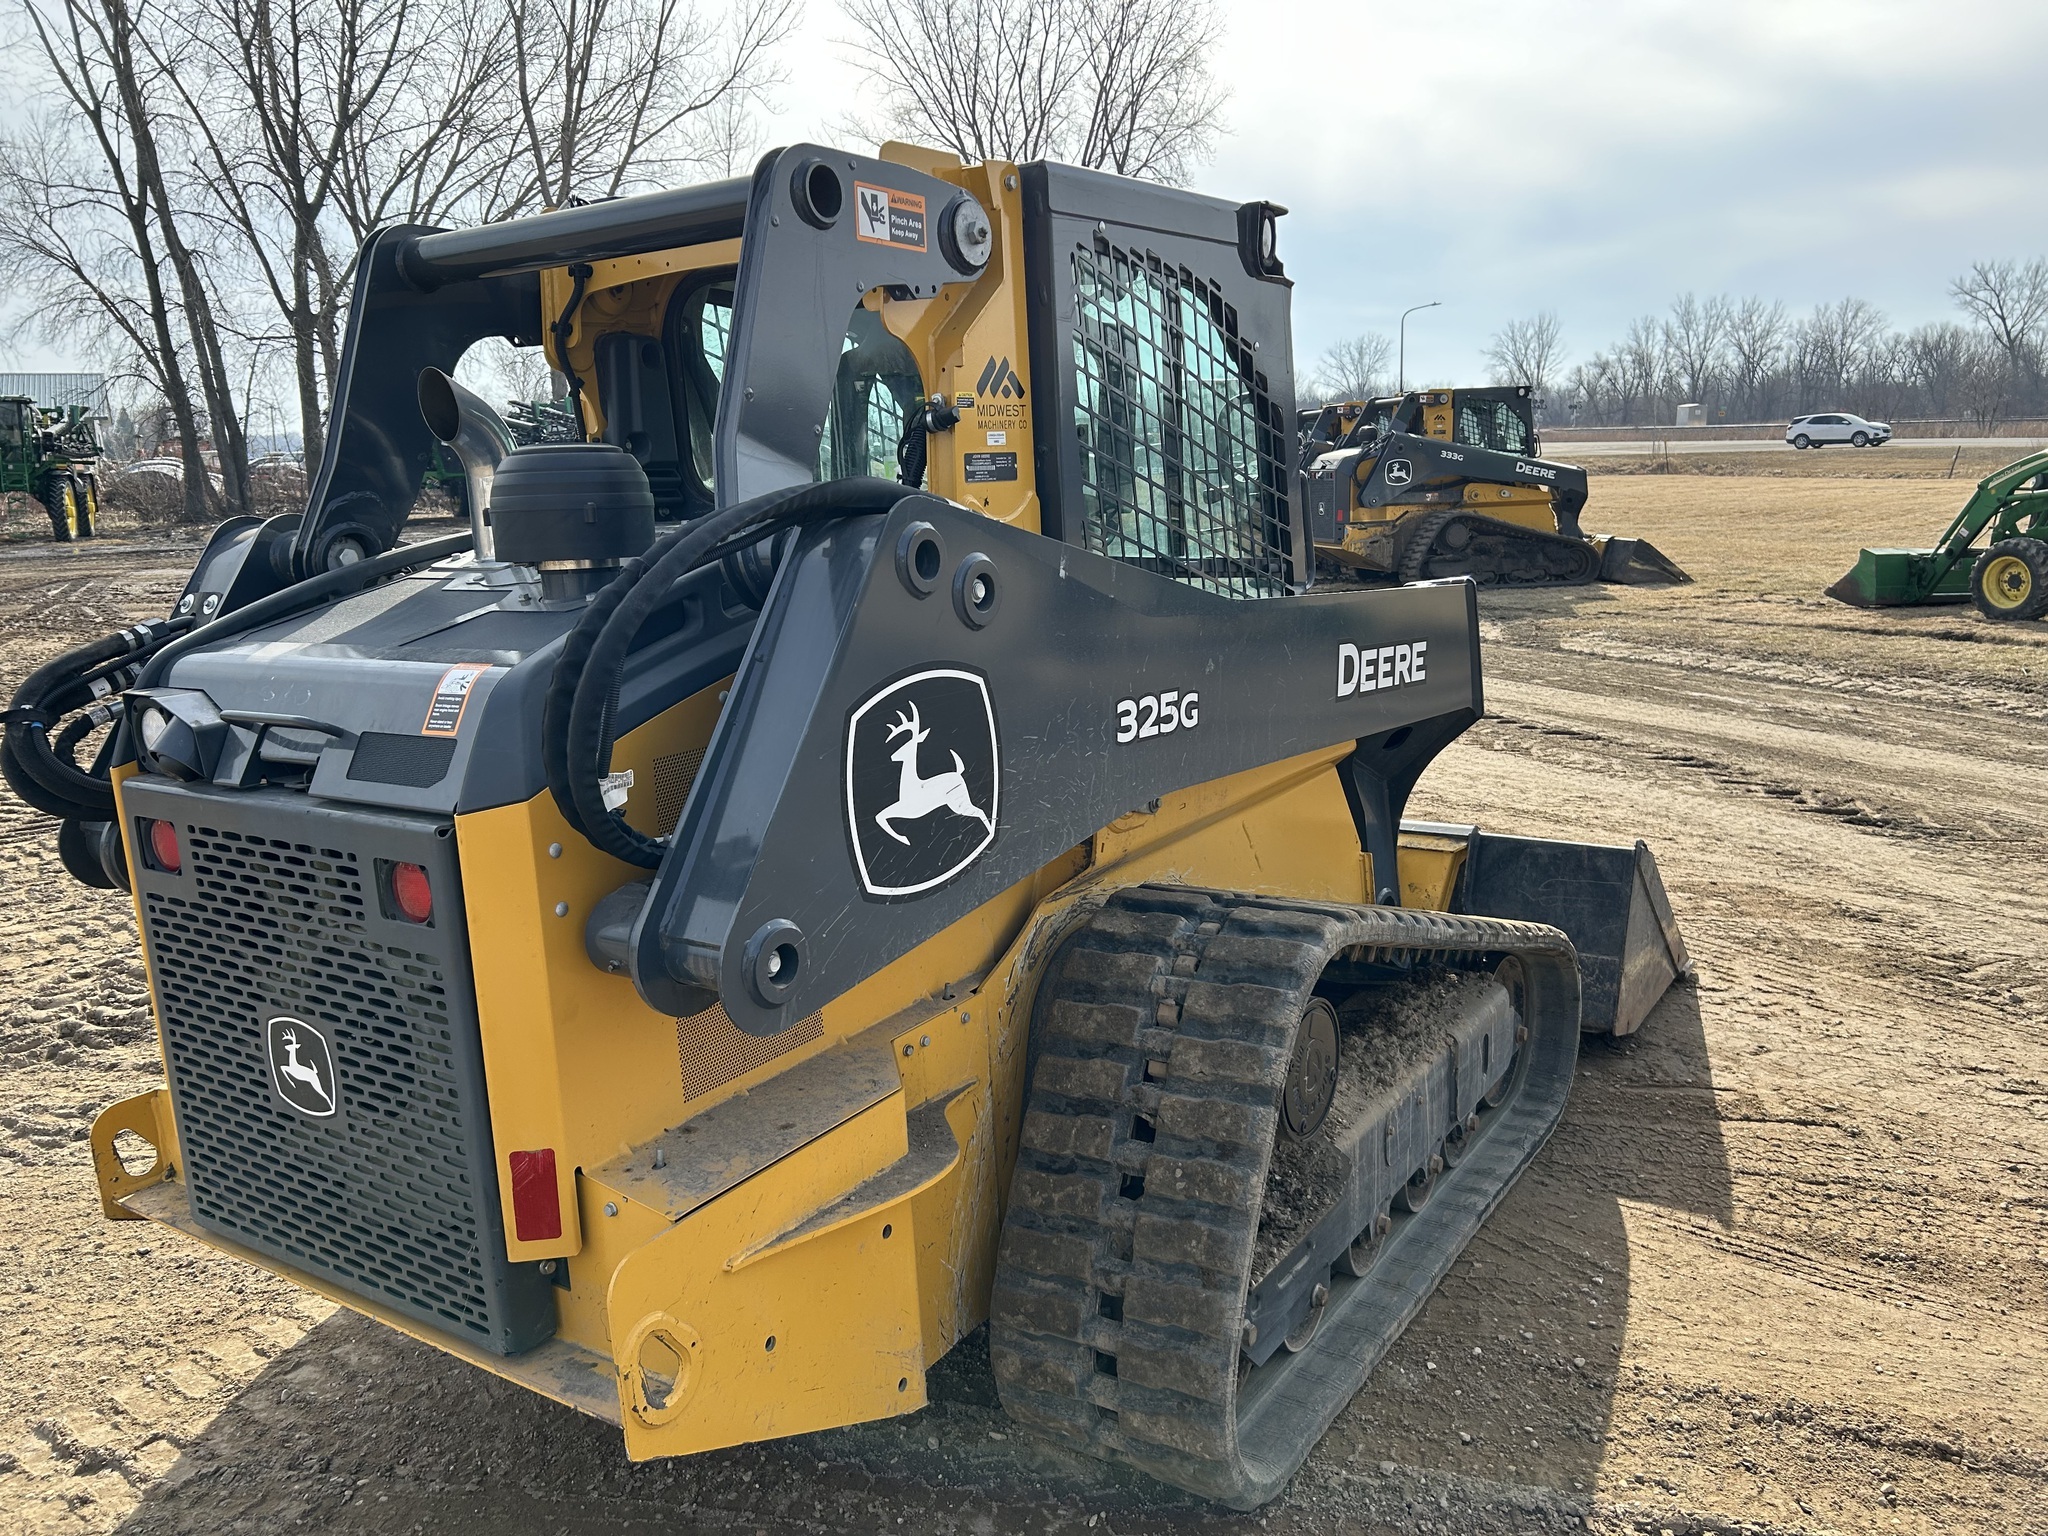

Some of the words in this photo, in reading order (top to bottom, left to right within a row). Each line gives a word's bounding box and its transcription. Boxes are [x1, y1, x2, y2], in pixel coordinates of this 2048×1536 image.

[896, 197, 922, 209] WARNING
[891, 214, 907, 226] Pinch
[908, 218, 922, 229] Area
[891, 227, 904, 237] Keep
[905, 230, 918, 240] Away
[977, 404, 1026, 417] MIDWEST
[977, 420, 1016, 429] MACHINERY
[1018, 419, 1027, 429] CO
[1440, 450, 1464, 462] 333G
[1515, 461, 1557, 479] DEERE
[1337, 641, 1427, 697] DEERE
[1116, 691, 1198, 743] 325G
